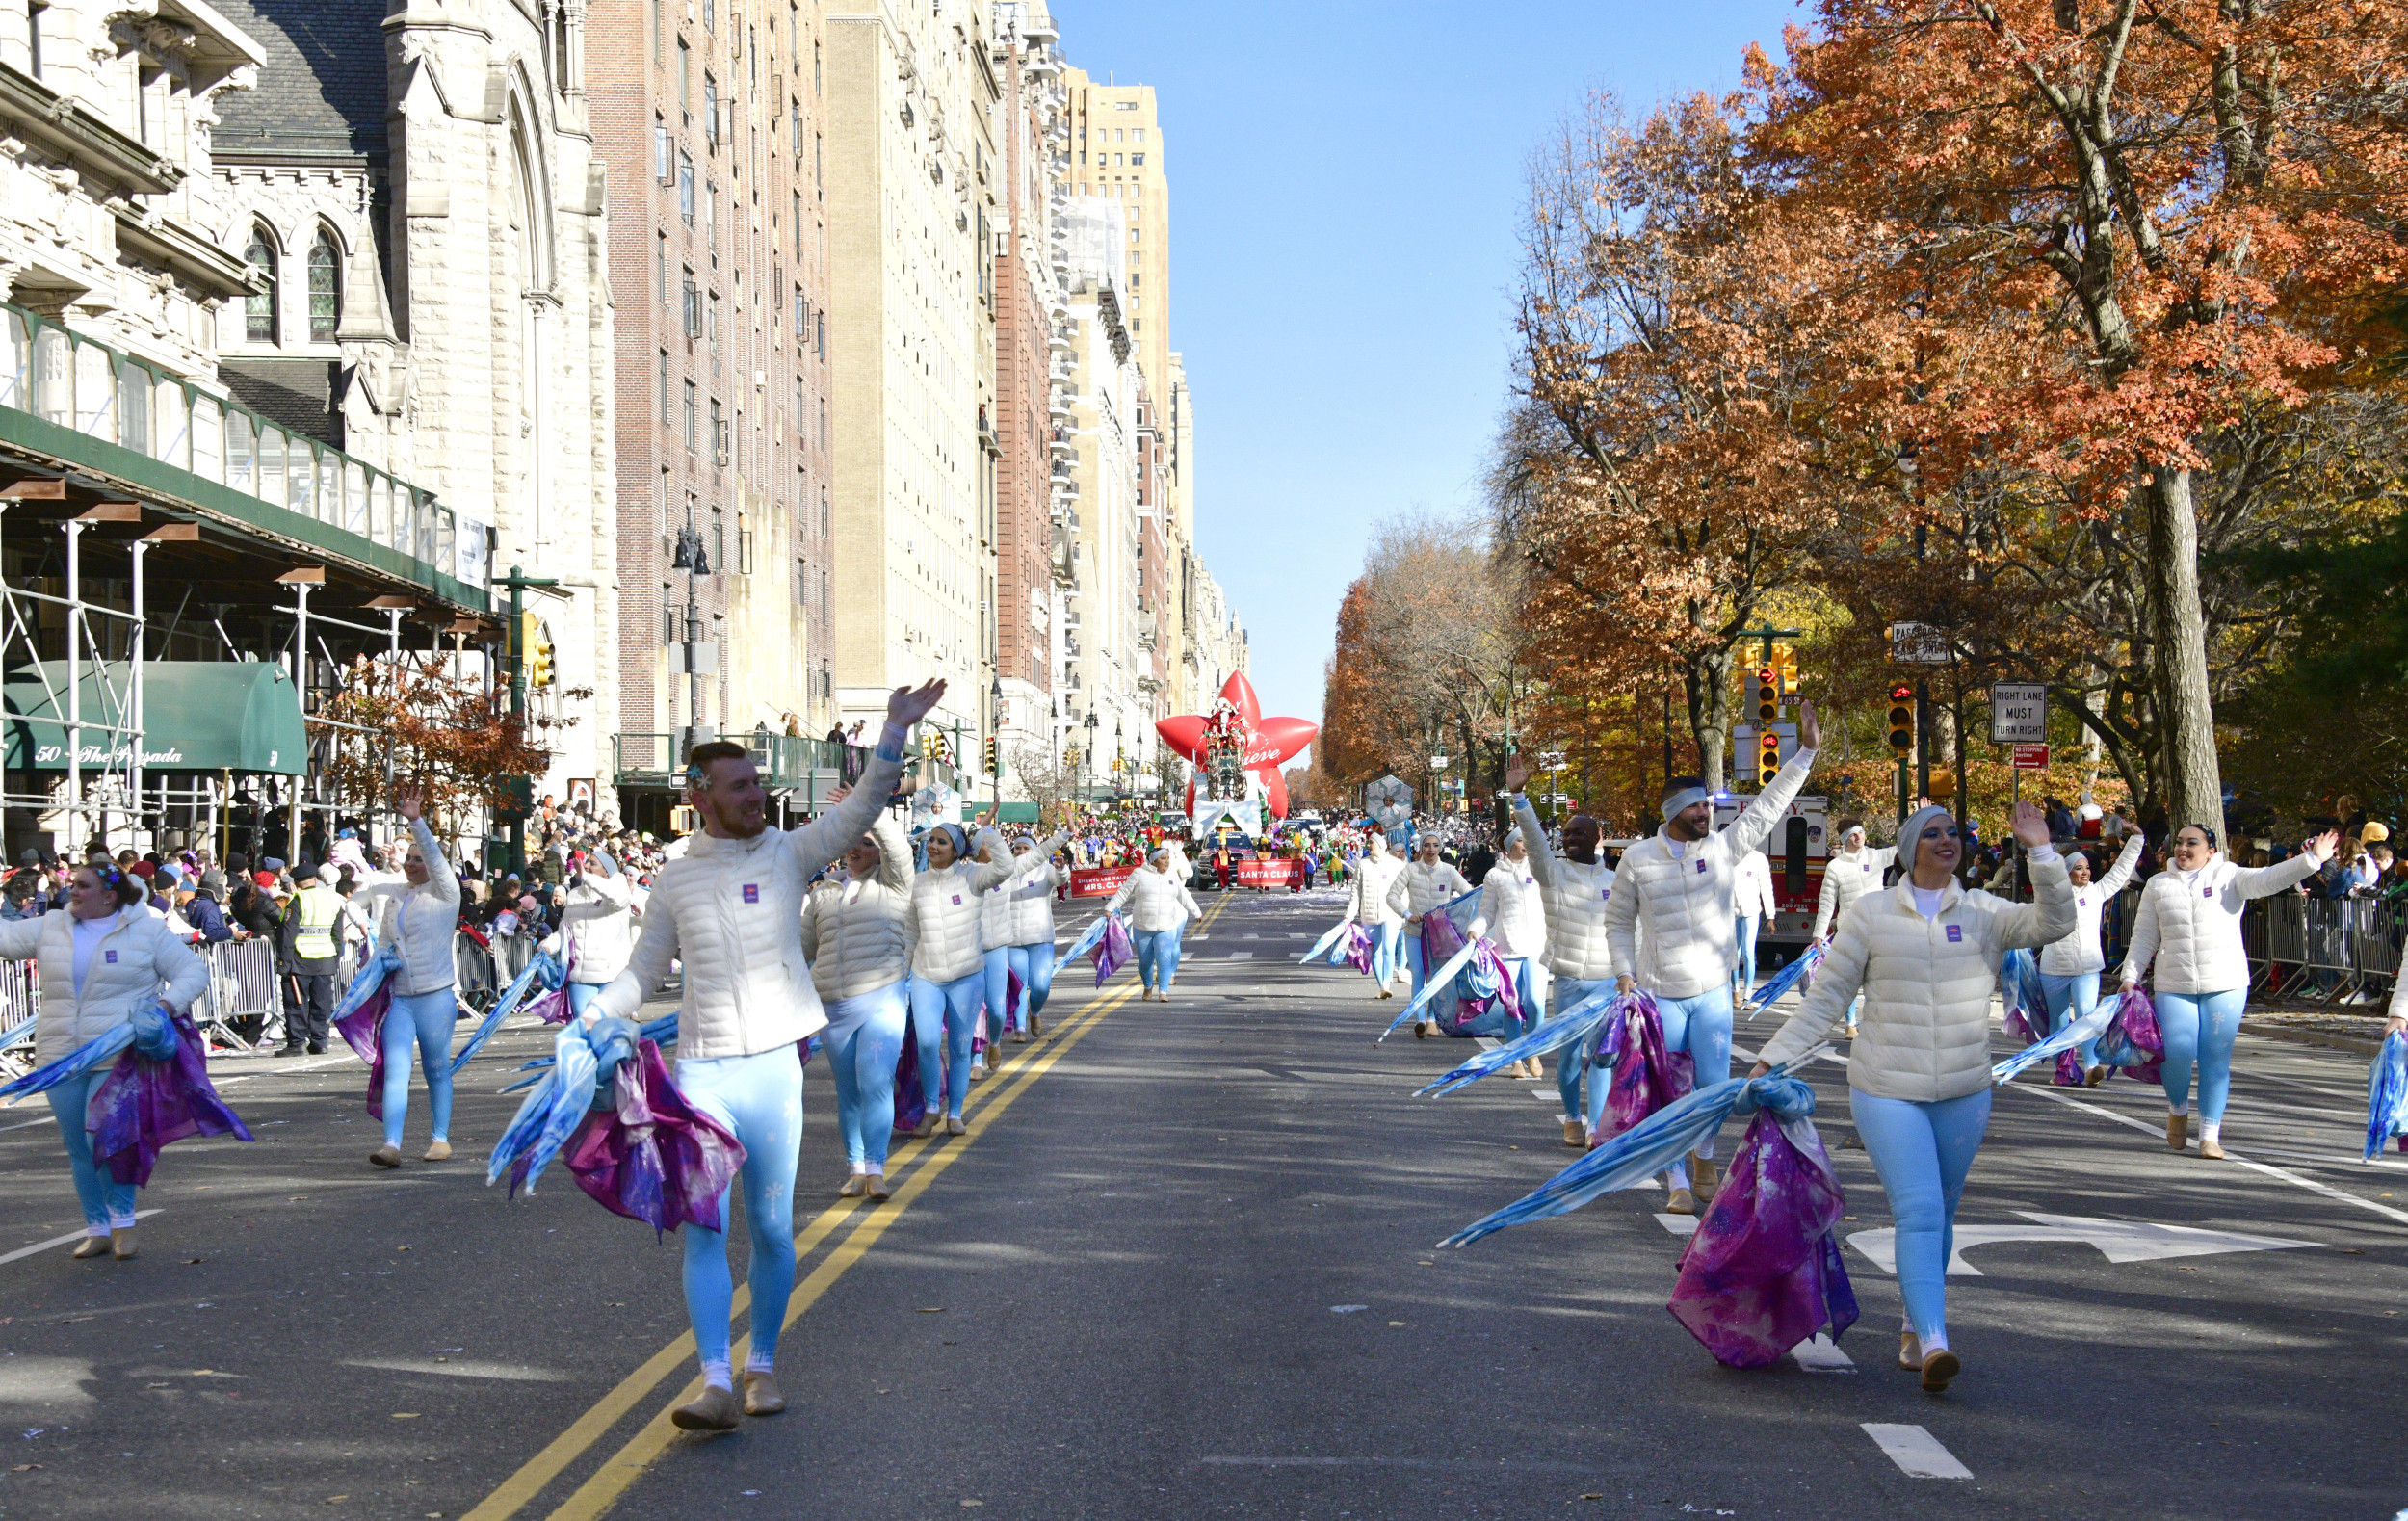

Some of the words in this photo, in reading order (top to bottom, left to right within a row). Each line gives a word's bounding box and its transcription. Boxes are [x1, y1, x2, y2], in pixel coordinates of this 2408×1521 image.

[1784, 696, 1793, 705] 65
[1996, 691, 2020, 701] RIGHT
[2023, 692, 2043, 701] LANE
[2005, 707, 2032, 719] MUST
[1996, 725, 2016, 735] TURN
[2019, 725, 2043, 735] RIGHT
[35, 745, 62, 762] 50
[79, 745, 110, 763] The
[1106, 880, 1126, 889] CLA
